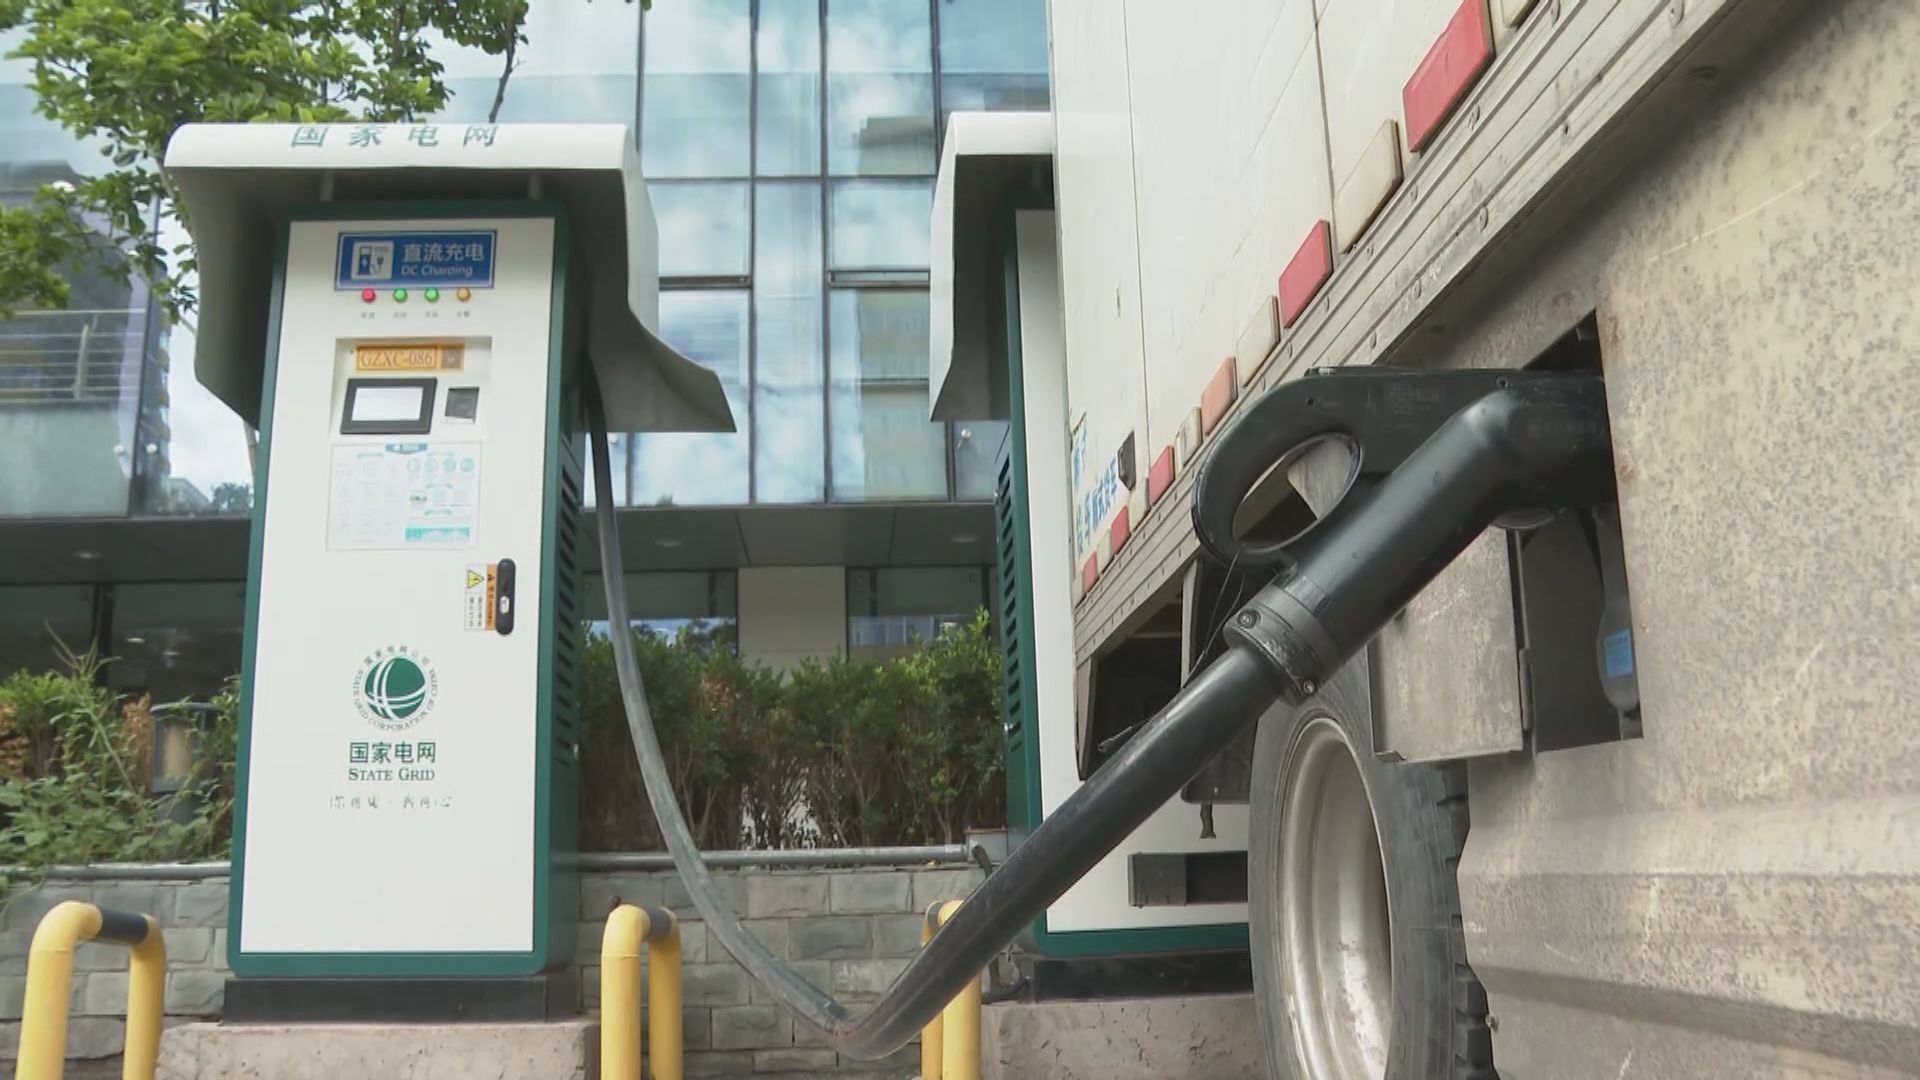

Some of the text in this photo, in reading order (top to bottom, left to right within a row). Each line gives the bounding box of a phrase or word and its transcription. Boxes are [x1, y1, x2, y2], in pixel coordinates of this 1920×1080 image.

[291, 124, 499, 147] 国家电网
[402, 243, 485, 263] 直流充电
[400, 264, 473, 278] DC Charging
[359, 350, 433, 367] GZXC-086
[349, 740, 436, 764] 国家电网
[348, 766, 435, 781] STATE GRID
